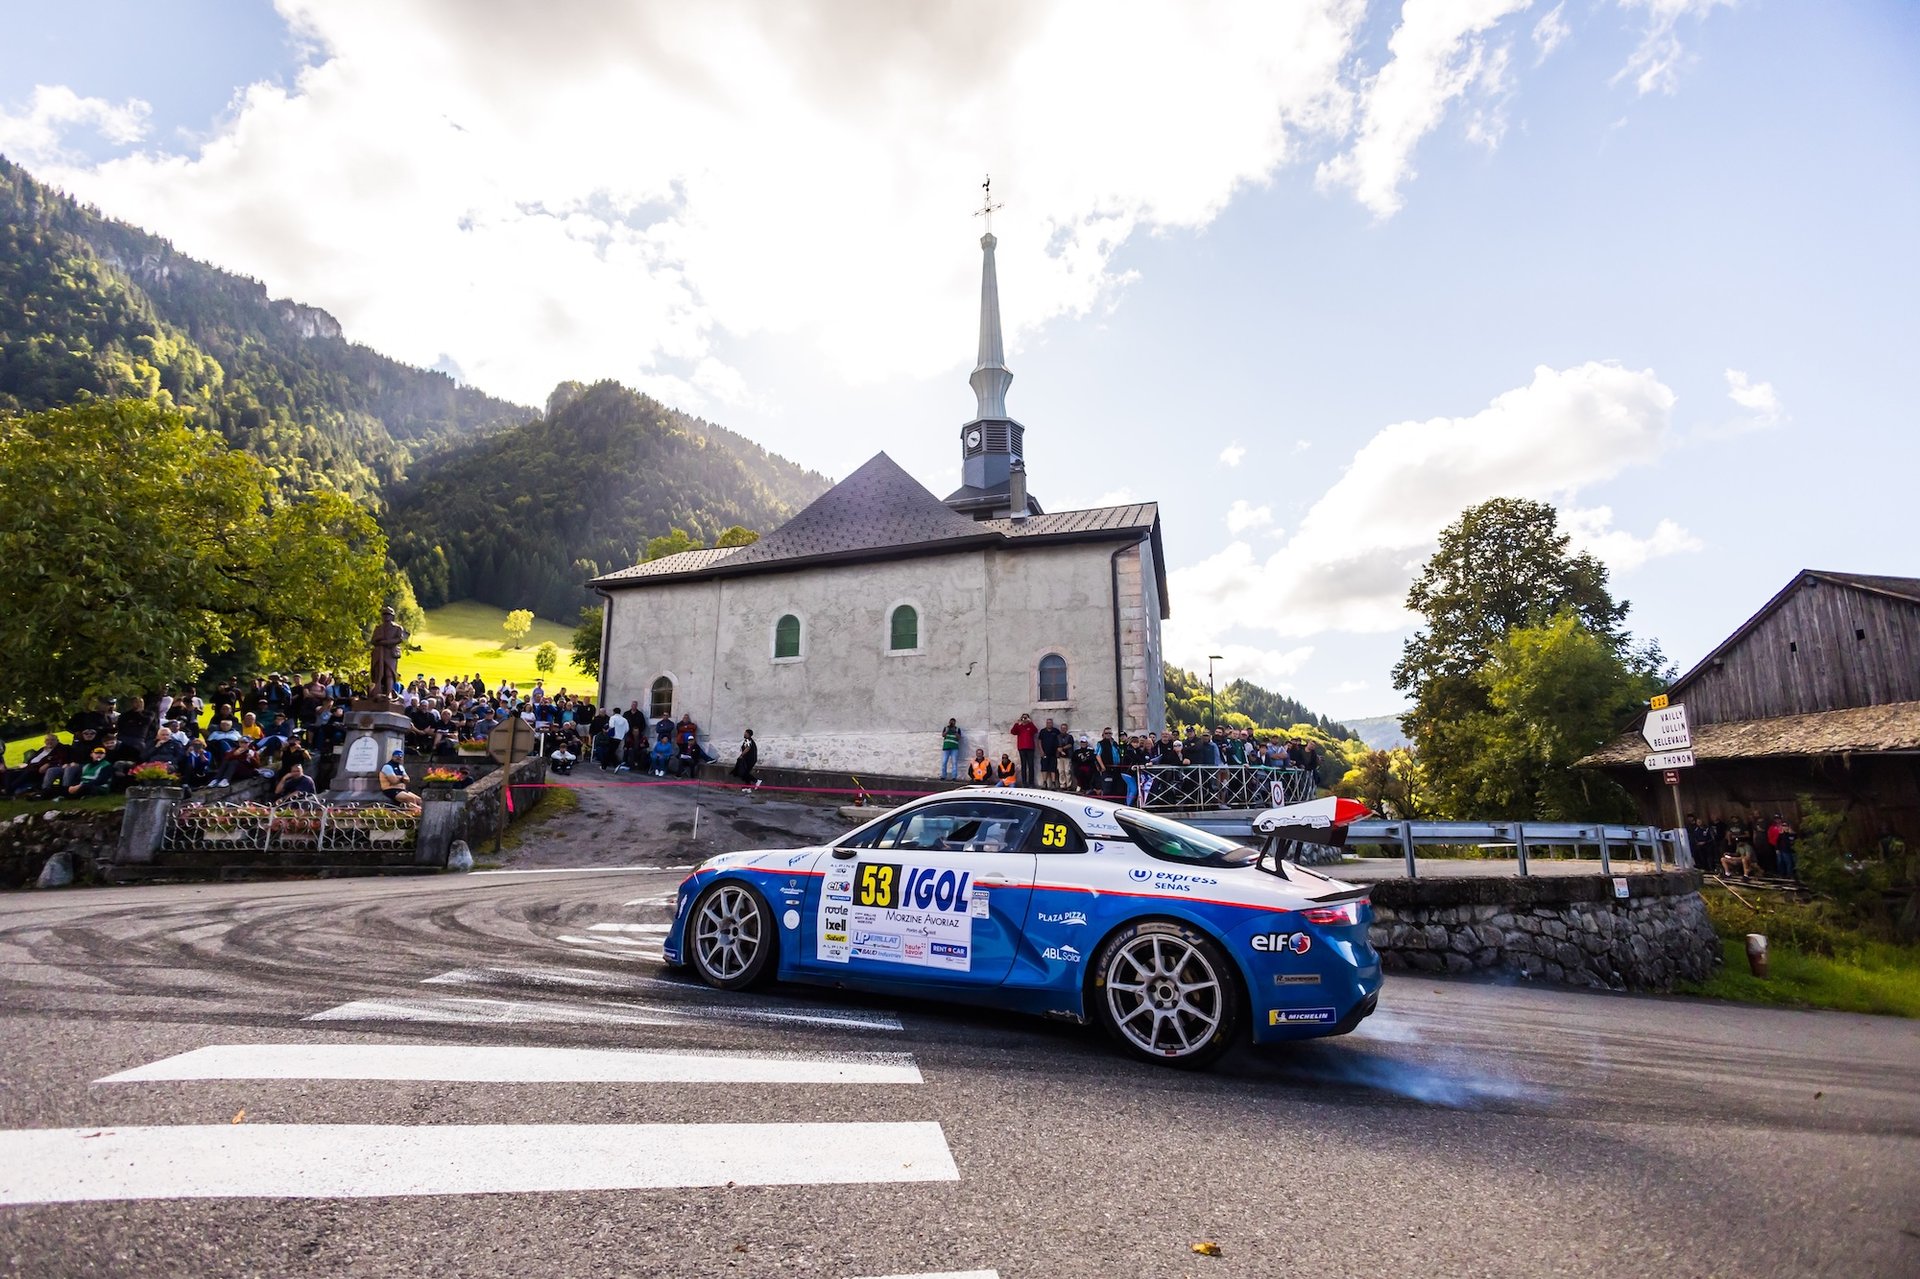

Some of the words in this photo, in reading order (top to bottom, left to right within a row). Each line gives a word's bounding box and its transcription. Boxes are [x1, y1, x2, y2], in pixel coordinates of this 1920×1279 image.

[1661, 711, 1683, 721] VAILLY
[1662, 723, 1685, 734] LULLIN
[1654, 735, 1687, 747] BELLEVAUX
[1649, 758, 1656, 767] 22
[1664, 754, 1691, 765] THONON
[1041, 823, 1068, 848] 53
[1156, 871, 1218, 885] express
[860, 865, 894, 907] 53
[902, 868, 970, 913] IGOL
[1155, 882, 1191, 892] SENAS
[886, 910, 922, 924] MORZINE
[924, 913, 960, 928] AVORIAZ
[1038, 912, 1063, 922] PLAZA
[1064, 911, 1087, 921] PIZZA
[825, 918, 846, 931] ixell
[1101, 928, 1135, 969] MICHELIN
[1251, 933, 1289, 951] elf
[932, 945, 947, 953] RENT
[952, 947, 965, 955] CAR
[1042, 947, 1062, 961] ABL
[1062, 951, 1081, 963] Solar
